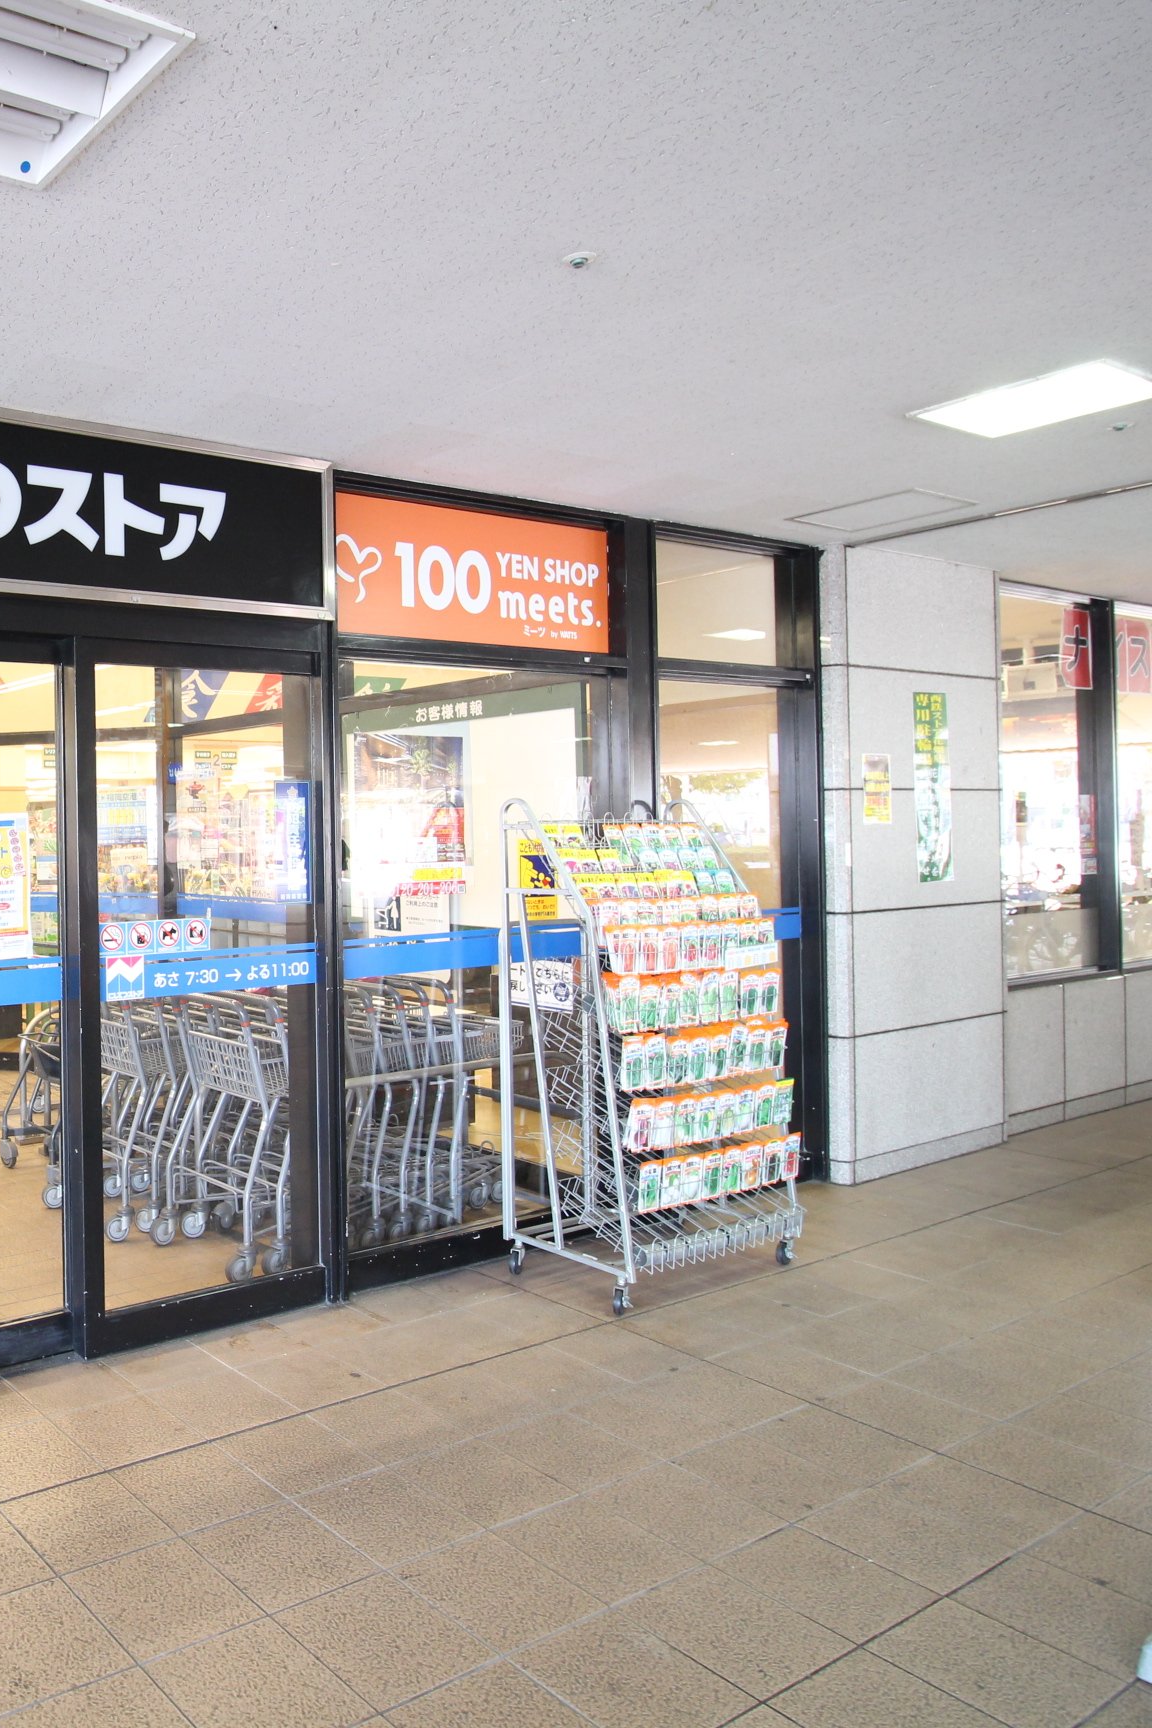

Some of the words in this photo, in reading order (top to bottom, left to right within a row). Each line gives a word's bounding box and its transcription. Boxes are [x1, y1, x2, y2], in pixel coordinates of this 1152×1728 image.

[394, 541, 492, 615] 100
[496, 551, 539, 581] YEN
[544, 558, 599, 588] SHOP
[497, 590, 601, 628] meets.
[523, 624, 546, 638] ミーツ
[550, 631, 558, 640] by
[559, 630, 578, 640] WATTS
[415, 700, 483, 723] お客様情報
[153, 971, 180, 988] あさ
[185, 968, 219, 986] 7:30
[247, 961, 310, 981] よる11:00
